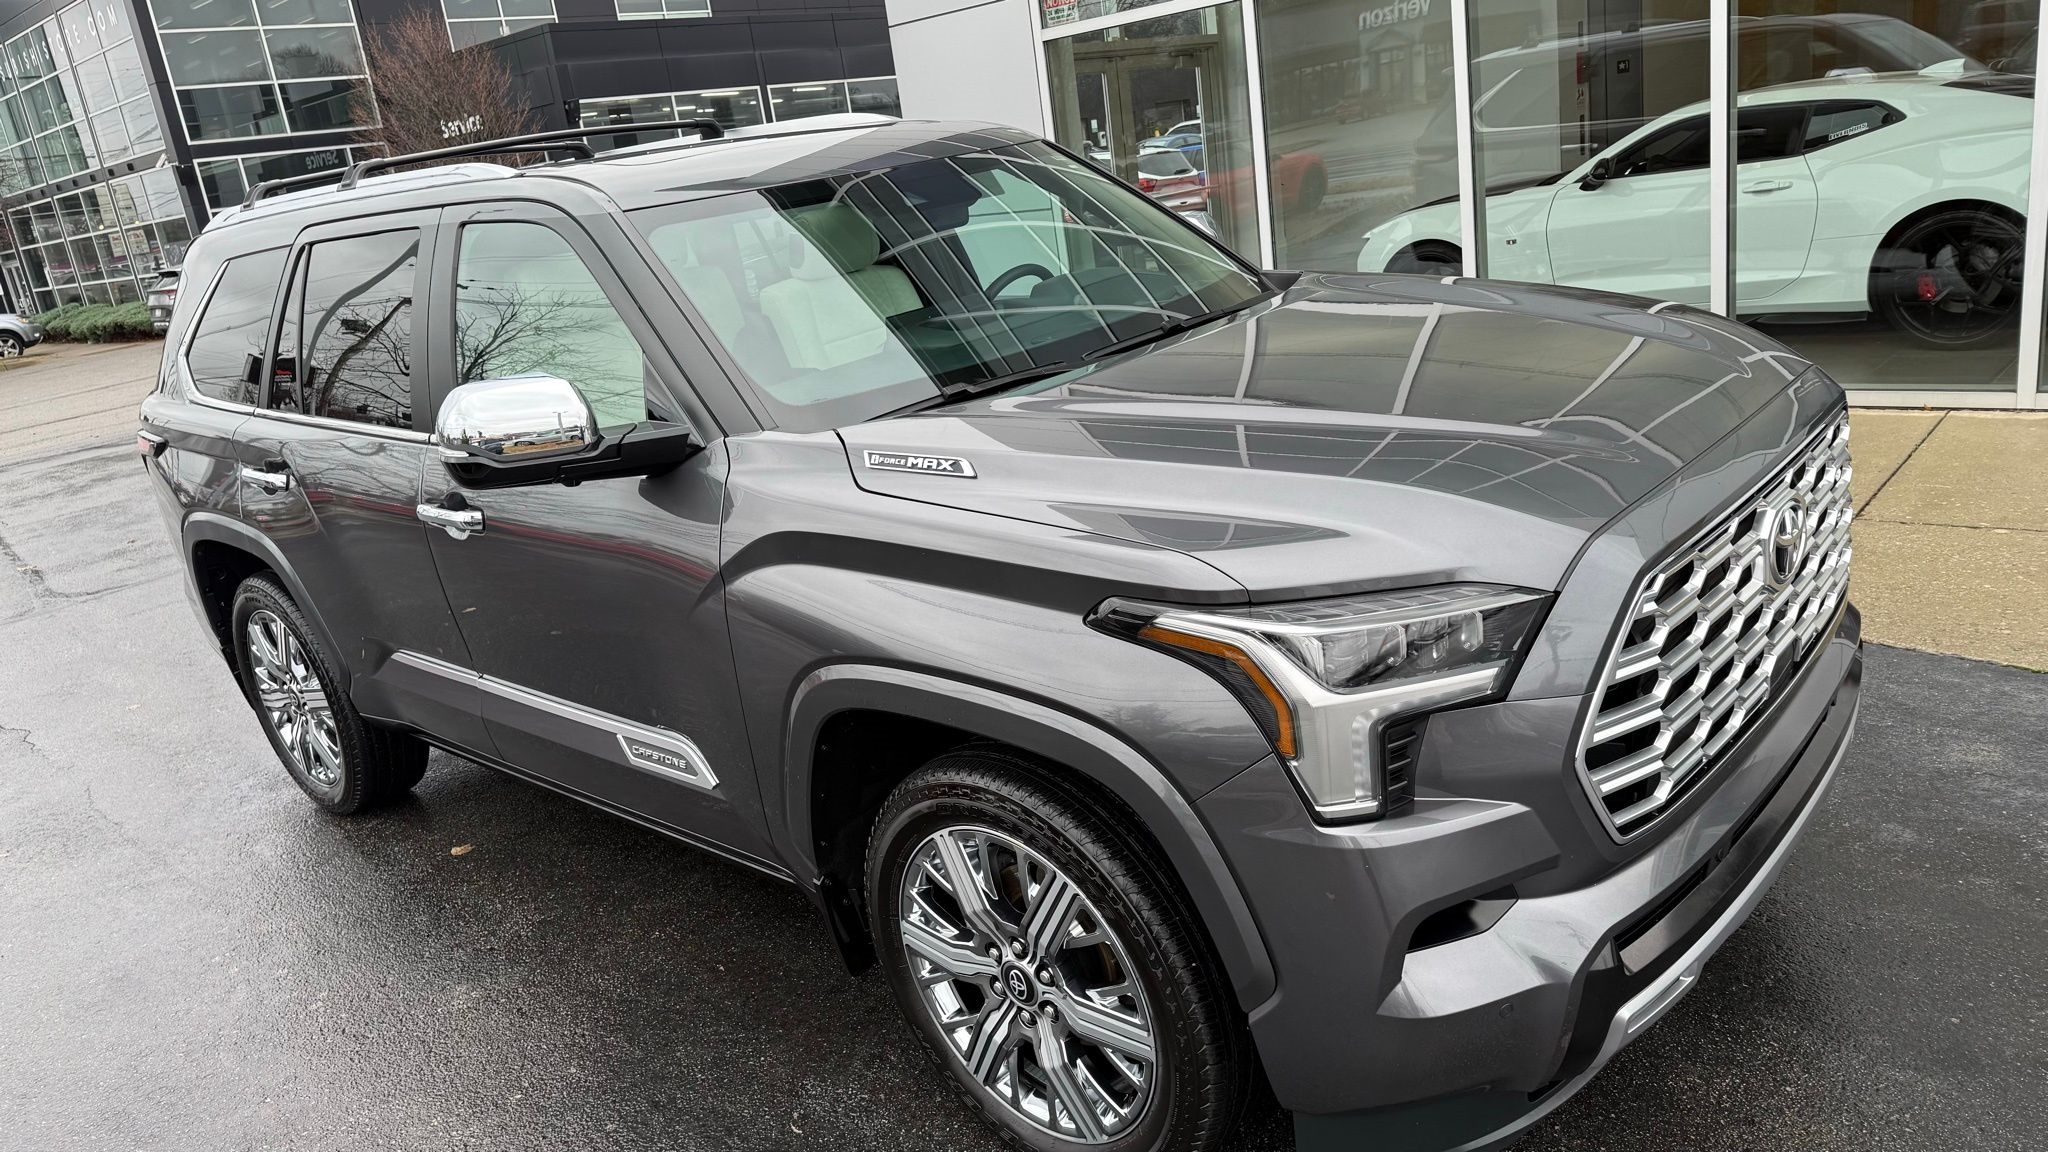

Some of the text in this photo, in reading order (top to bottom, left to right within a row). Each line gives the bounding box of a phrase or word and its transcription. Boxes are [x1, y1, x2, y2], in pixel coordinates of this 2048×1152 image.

[440, 113, 483, 139] Service
[906, 456, 955, 472] MAX
[632, 745, 687, 769] CAPSTONE
